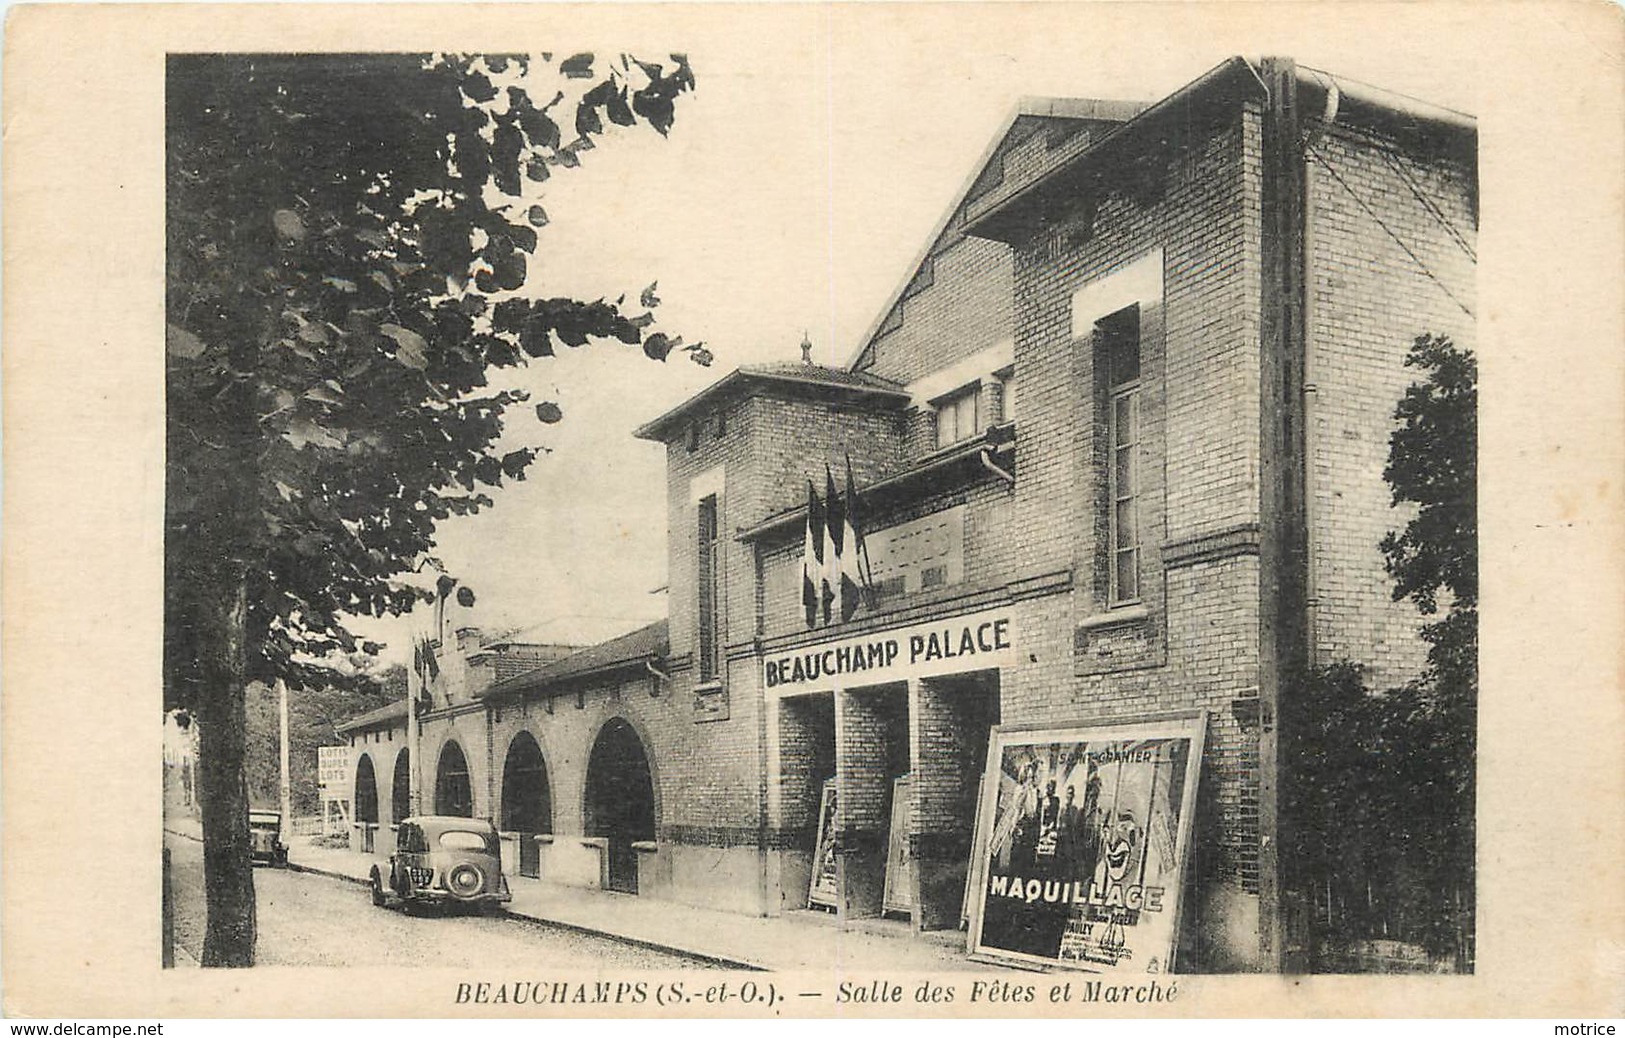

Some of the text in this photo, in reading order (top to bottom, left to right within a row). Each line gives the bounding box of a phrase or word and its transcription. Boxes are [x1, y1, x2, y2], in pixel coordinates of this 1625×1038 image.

[766, 618, 1011, 687] BEAUCHAMP PALACE
[990, 875, 1165, 912] MAQUILLAGE
